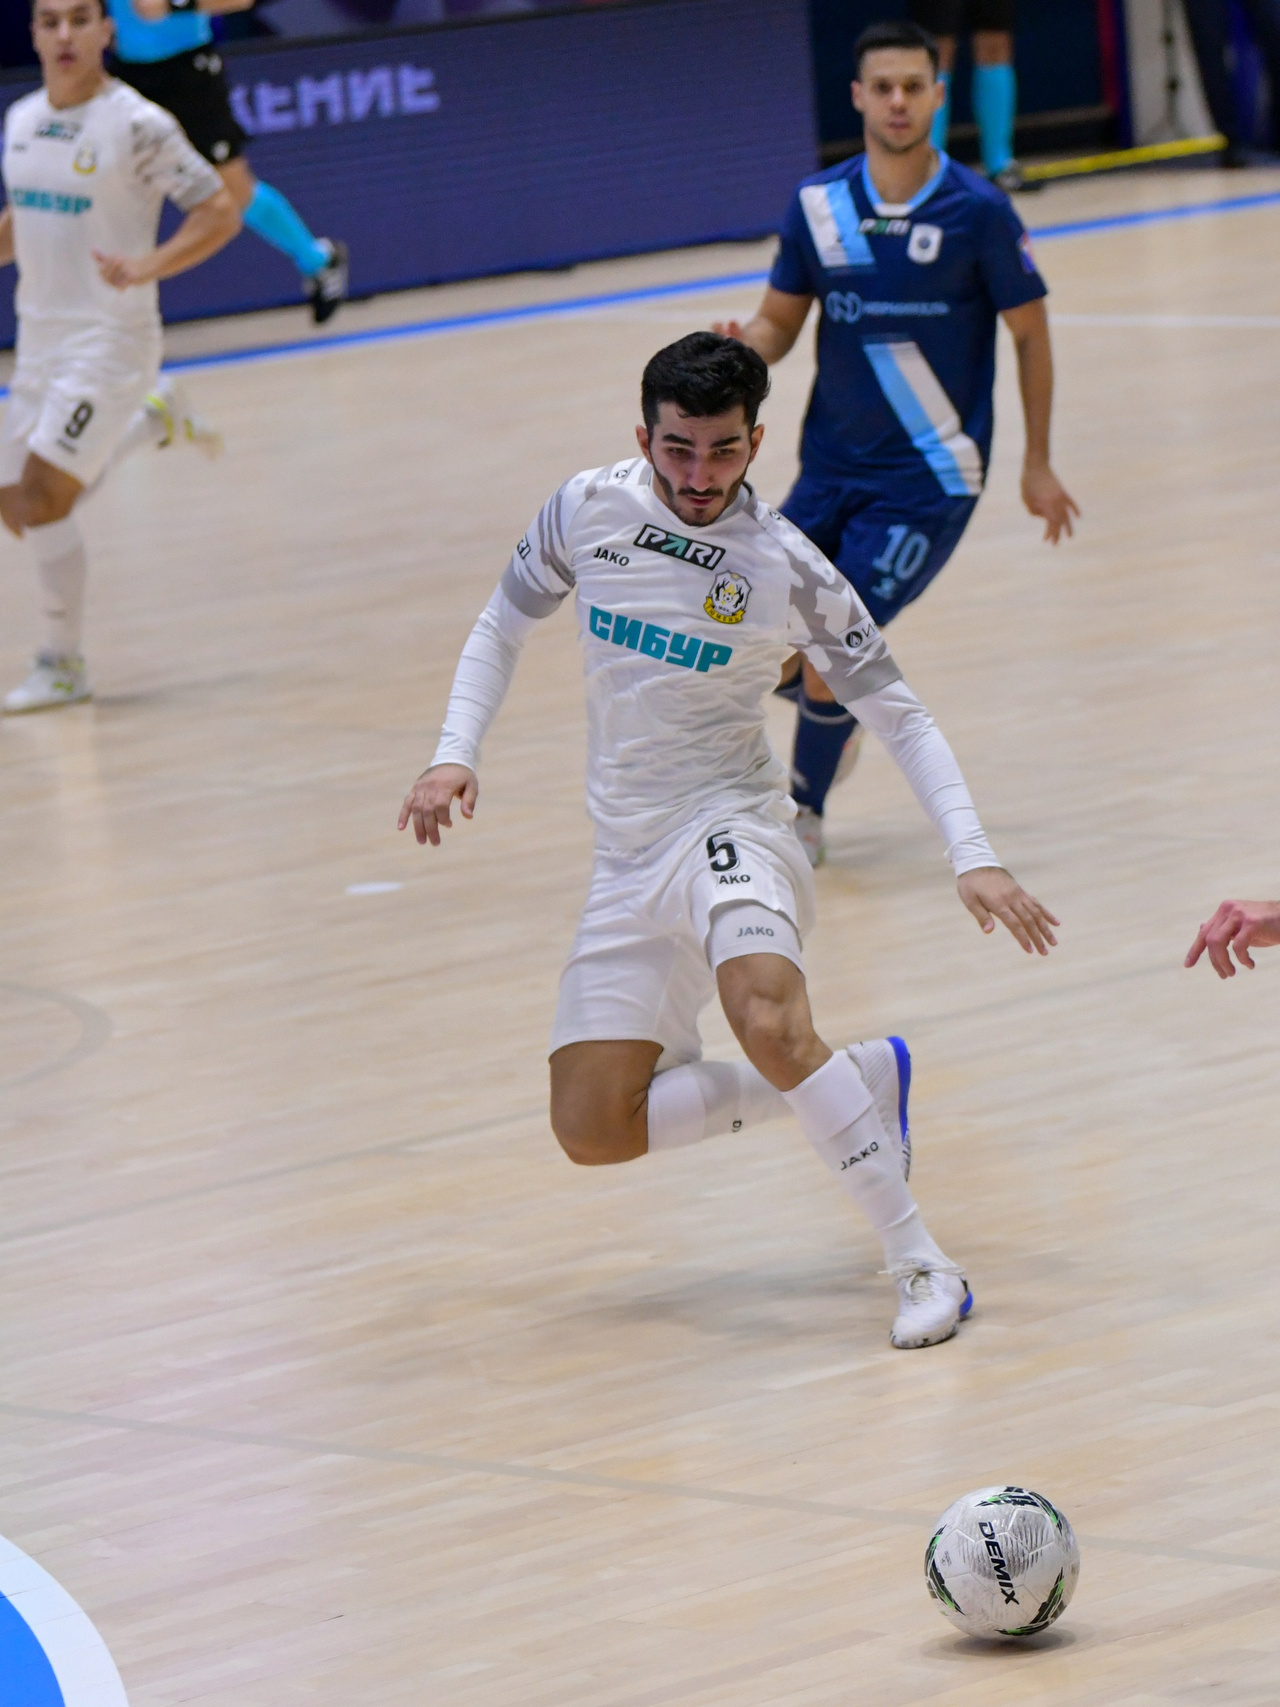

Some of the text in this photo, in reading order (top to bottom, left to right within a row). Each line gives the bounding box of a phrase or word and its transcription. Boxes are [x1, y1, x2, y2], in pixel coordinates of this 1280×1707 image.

[65, 402, 94, 439] 9
[593, 547, 629, 567] JAKO
[637, 525, 722, 568] PARI
[872, 524, 930, 581] 10
[590, 605, 733, 673] СИБУР
[706, 830, 738, 872] 5
[715, 874, 751, 885] AKO
[736, 926, 775, 937] JAKO
[840, 1141, 879, 1170] JAKO
[978, 1521, 1020, 1606] DEMIX
